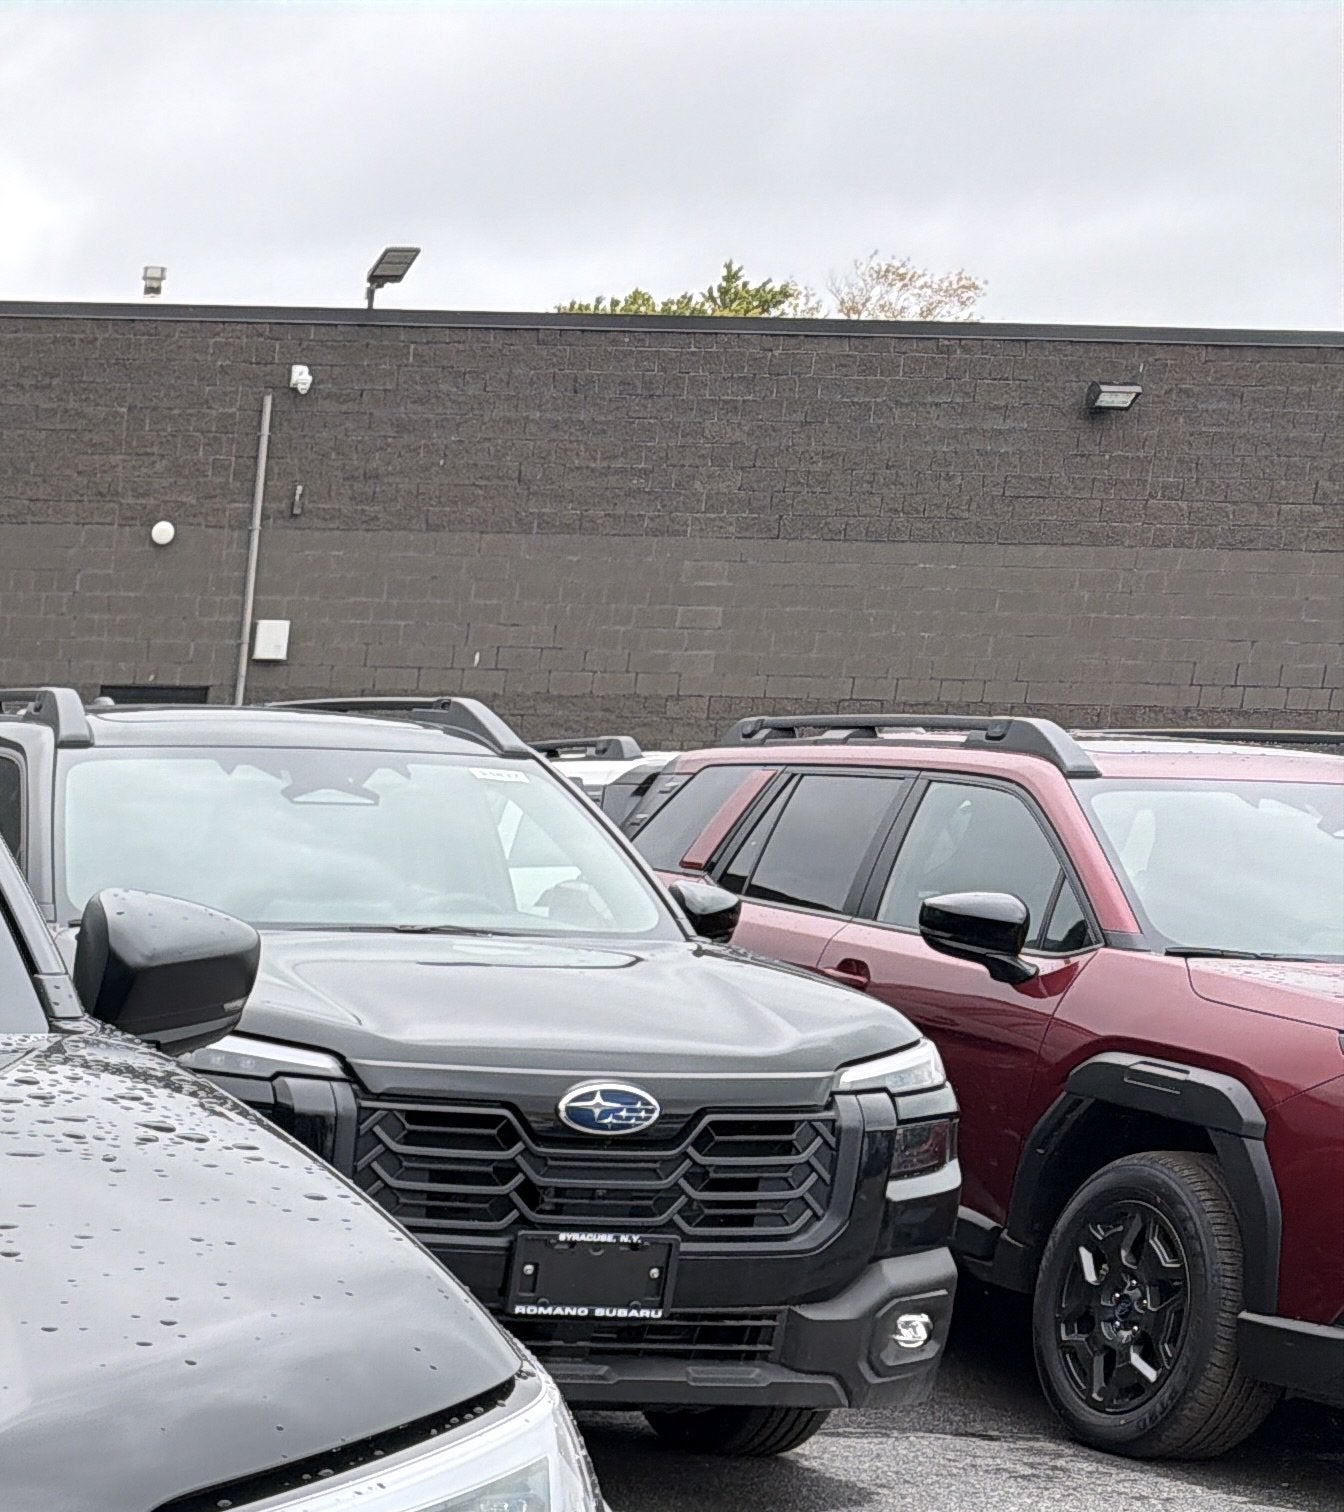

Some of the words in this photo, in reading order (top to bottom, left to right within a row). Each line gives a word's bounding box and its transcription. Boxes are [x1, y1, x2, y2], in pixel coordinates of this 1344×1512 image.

[620, 1234, 641, 1244] N.Y.
[514, 1305, 589, 1316] ROMANO
[594, 1307, 663, 1318] SUBARU
